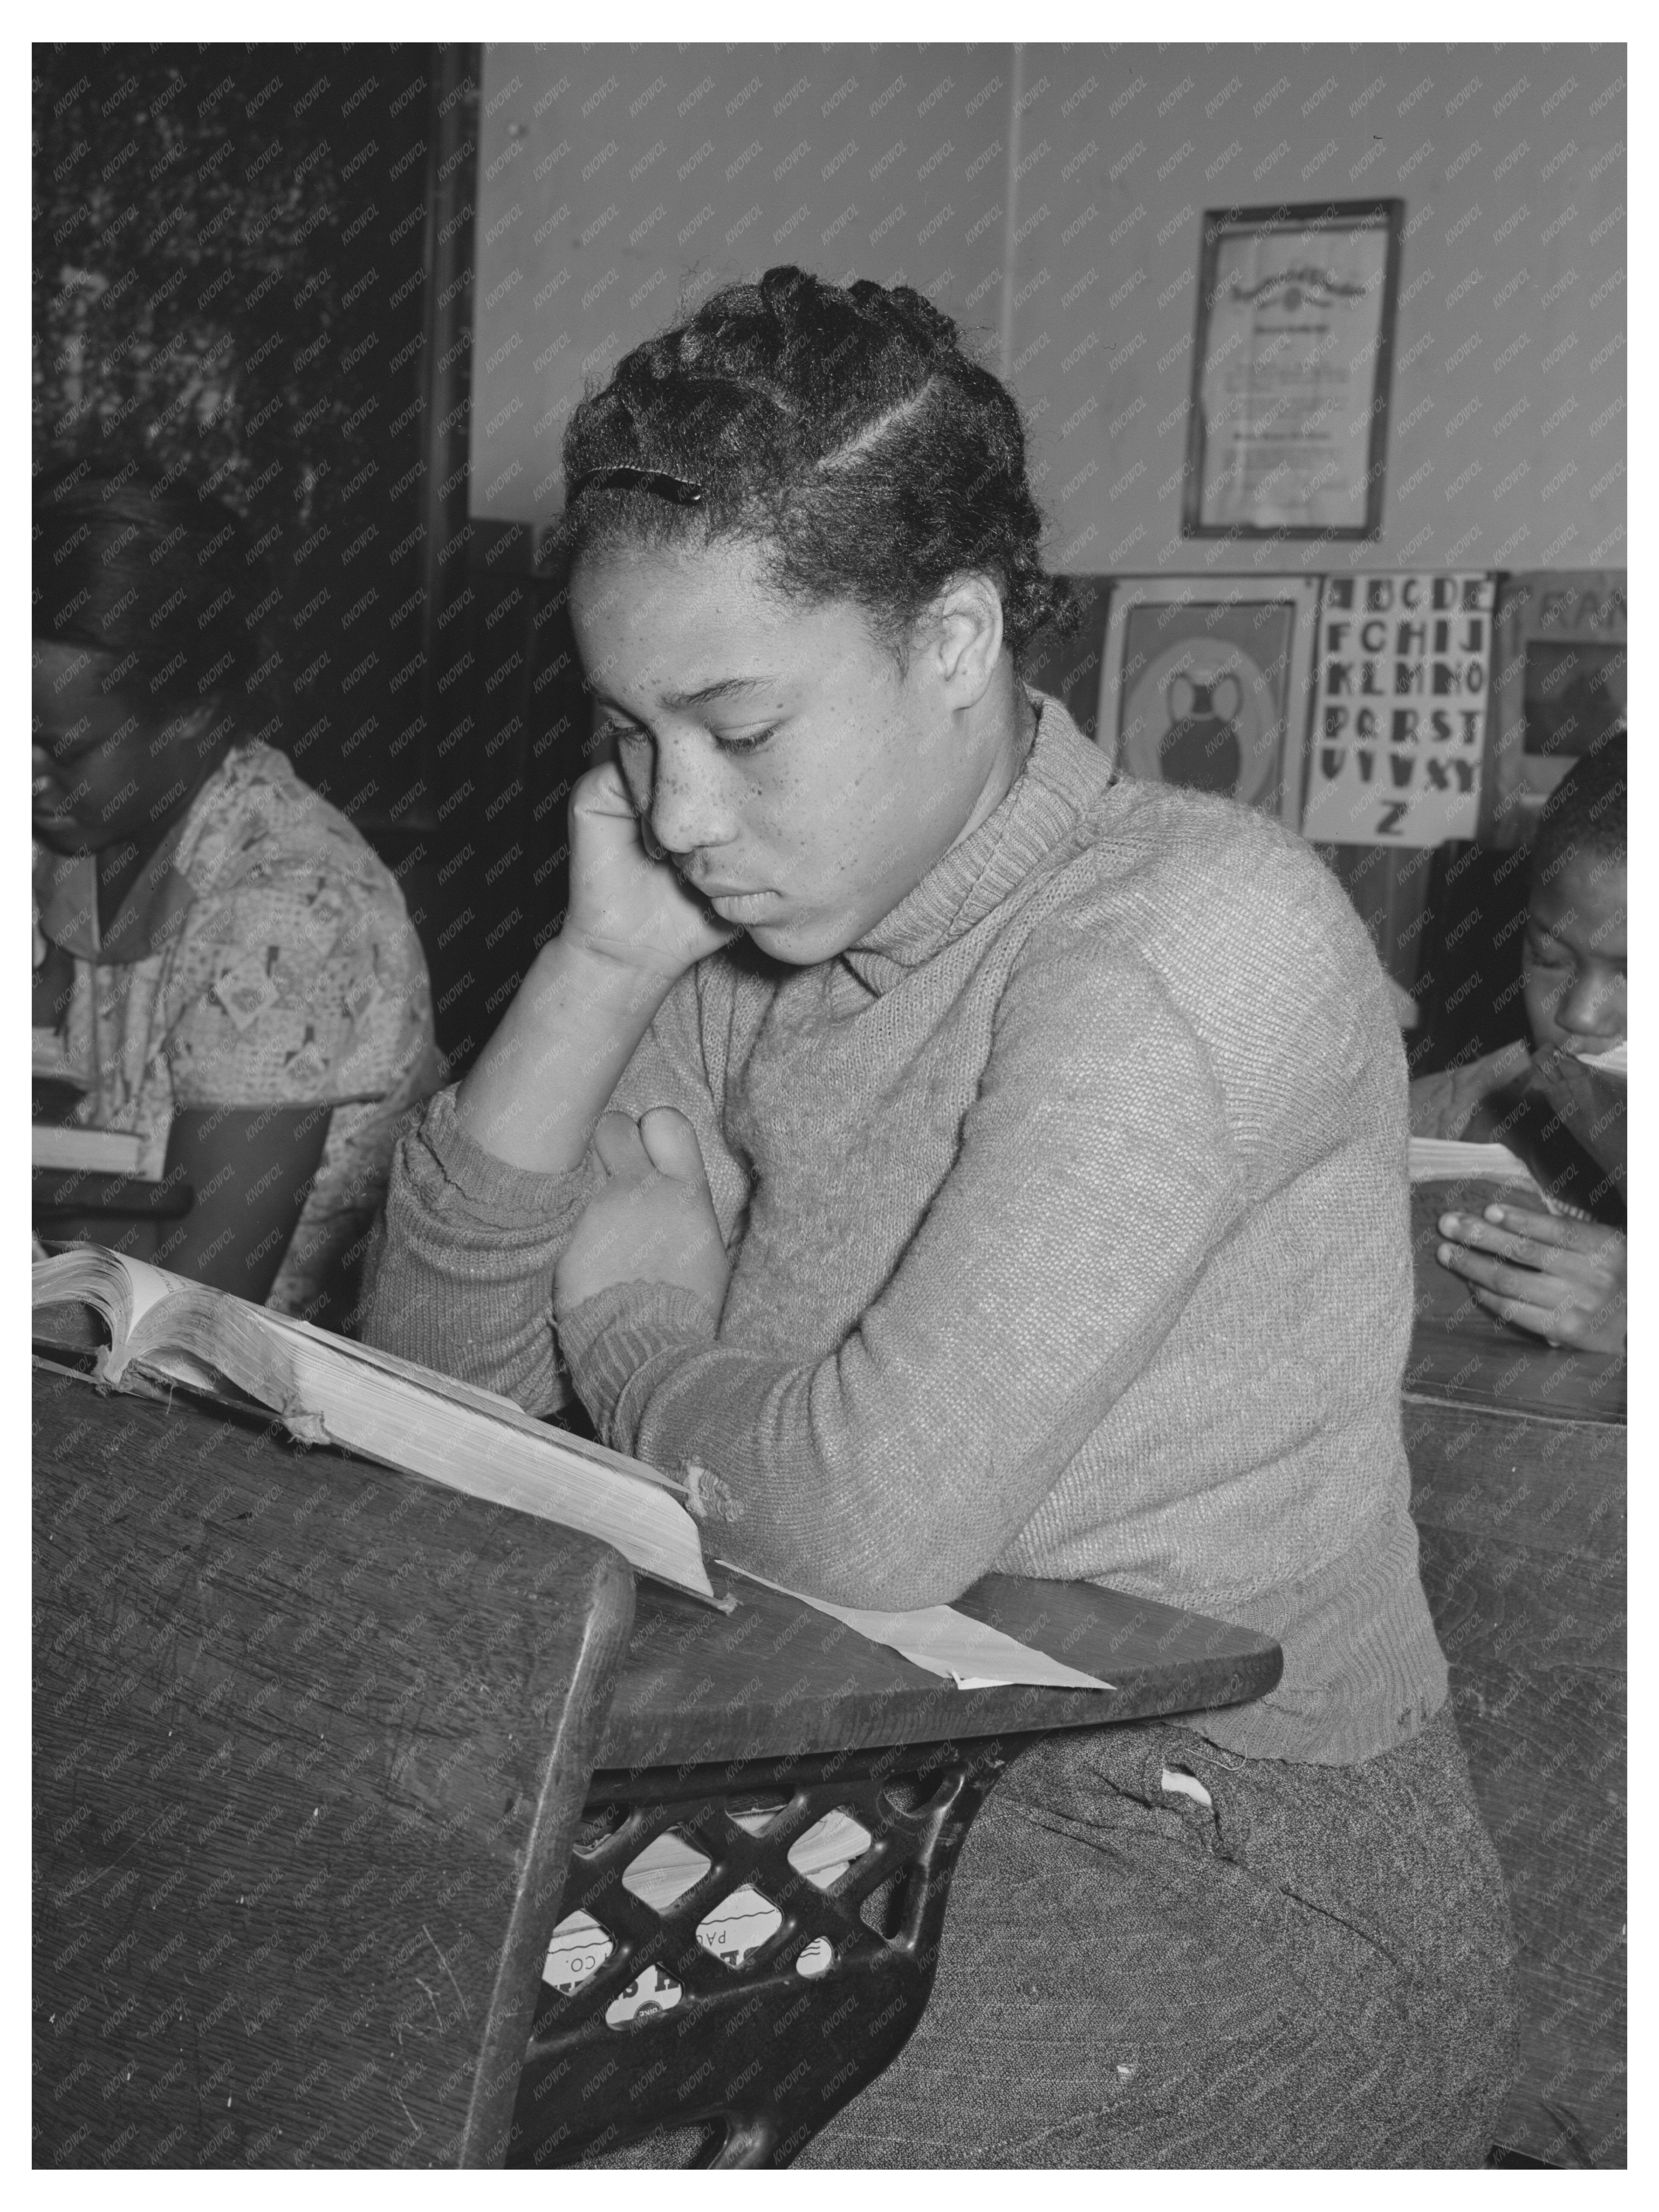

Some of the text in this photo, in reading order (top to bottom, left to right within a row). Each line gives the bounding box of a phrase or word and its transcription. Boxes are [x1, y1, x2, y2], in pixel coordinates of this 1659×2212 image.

[1402, 579, 1420, 609] C
[1433, 578, 1458, 610] D
[1328, 623, 1351, 653] F
[1397, 621, 1425, 656] H
[1436, 619, 1448, 653] I
[1459, 619, 1482, 653] J
[1327, 663, 1352, 695] K
[1362, 661, 1385, 695] L
[1467, 662, 1484, 694] O
[1325, 706, 1349, 739] P
[1392, 709, 1418, 743] R
[1431, 710, 1451, 742] S
[1459, 710, 1483, 745] T
[1322, 749, 1345, 780] U
[1425, 758, 1453, 791] X
[1454, 759, 1480, 793] Y
[1375, 801, 1408, 835] Z
[566, 1956, 595, 1973] CO.
